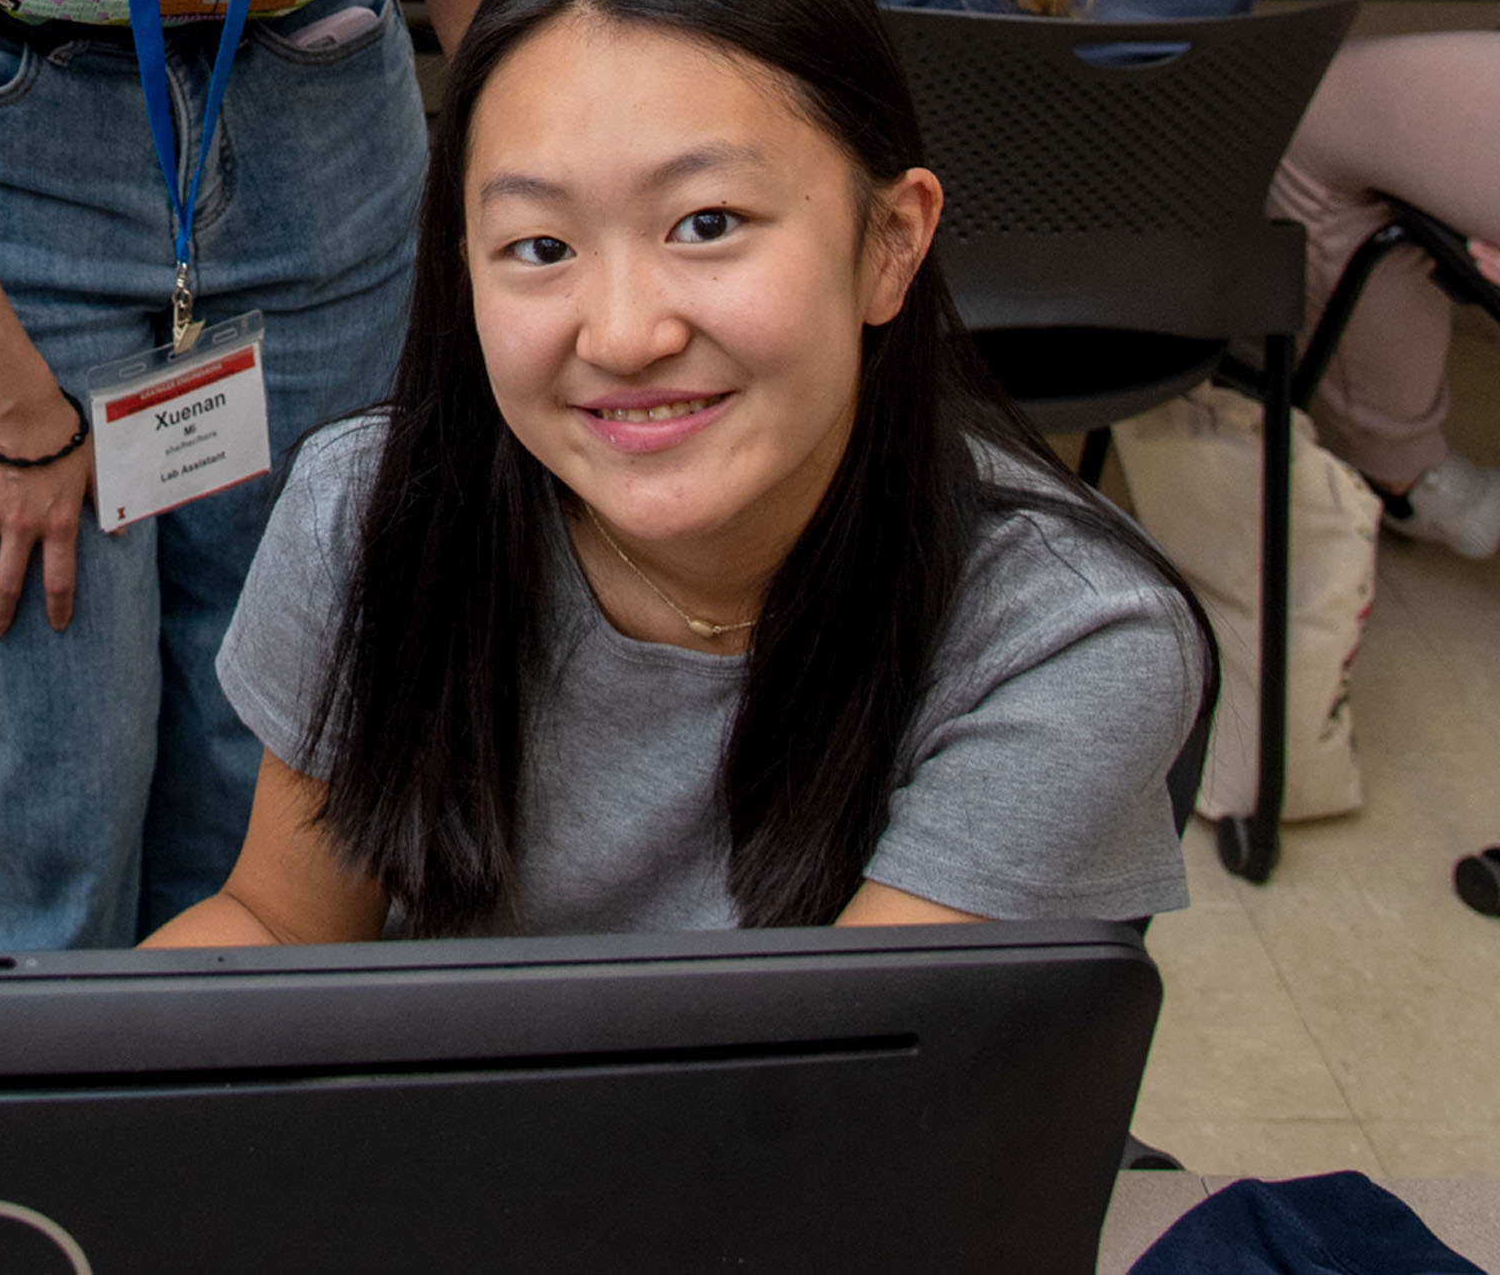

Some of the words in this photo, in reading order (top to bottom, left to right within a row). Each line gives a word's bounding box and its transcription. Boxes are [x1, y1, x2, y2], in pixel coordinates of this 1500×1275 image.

[155, 392, 226, 431] Xuenan
[160, 468, 180, 483] Lab
[181, 450, 227, 475] Assistant
